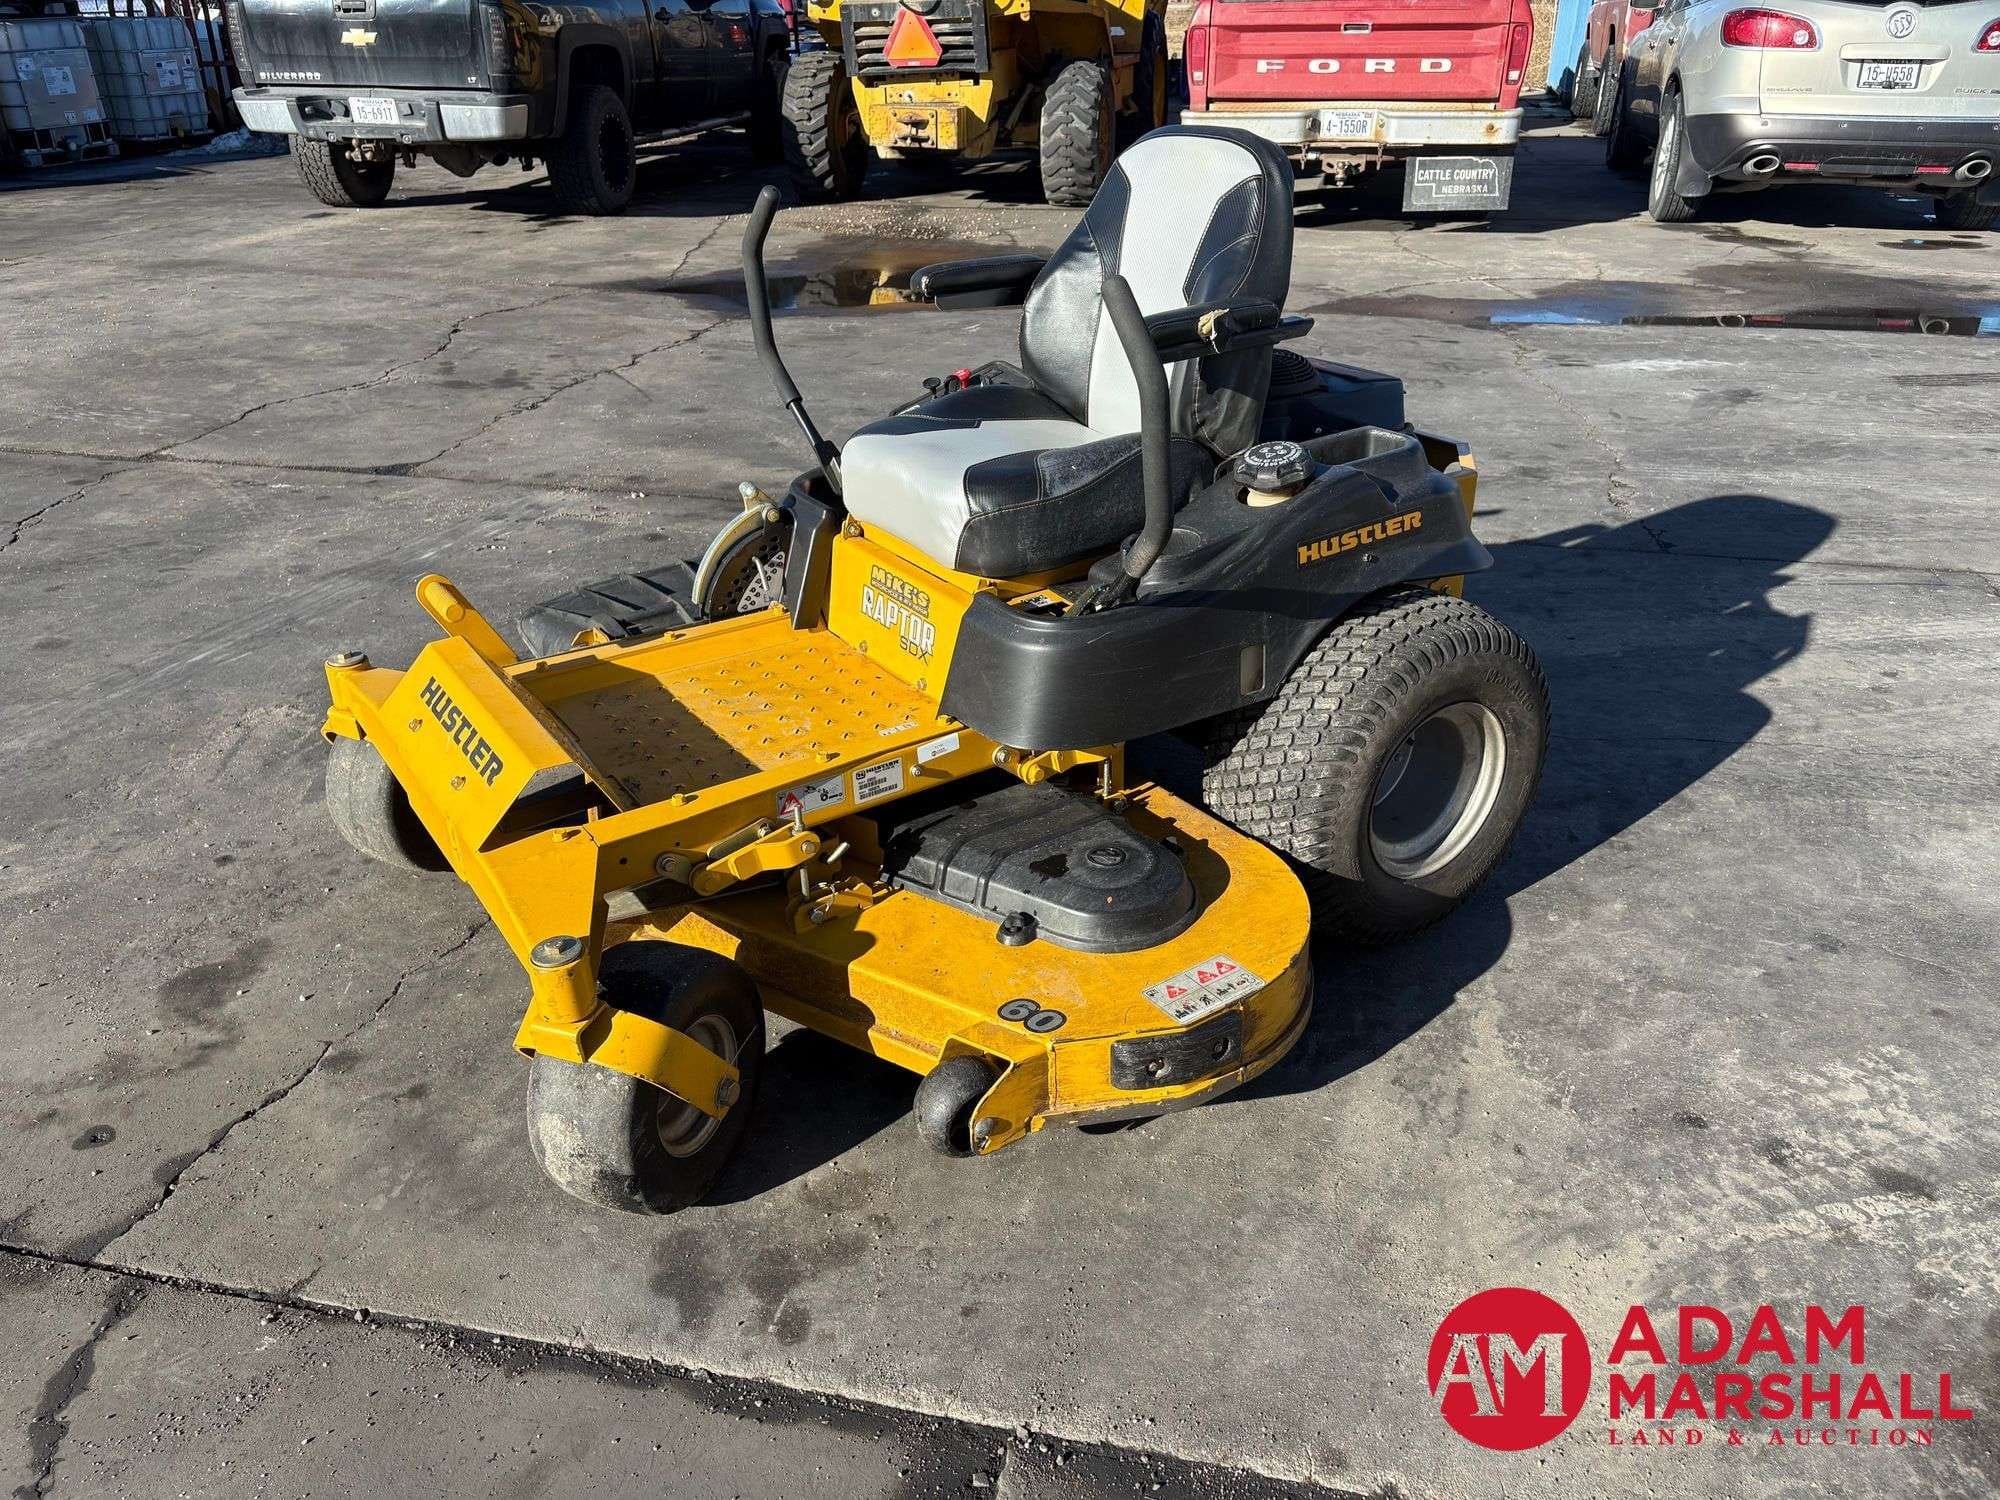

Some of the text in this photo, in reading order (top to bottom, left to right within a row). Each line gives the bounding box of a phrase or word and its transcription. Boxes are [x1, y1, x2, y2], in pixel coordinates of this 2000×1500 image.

[1256, 58, 1453, 73] FORD
[259, 71, 321, 80] SILVERADO
[357, 106, 393, 121] 15-691T
[1326, 119, 1368, 134] 4-1550R
[1418, 168, 1495, 181] CATTLE COUNTRY
[1441, 184, 1488, 194] NEBRASKA
[1297, 510, 1423, 565] HUSTLER
[862, 584, 936, 656] RAPTOR
[420, 676, 504, 787] HUSTLER
[998, 998, 1067, 1033] 60
